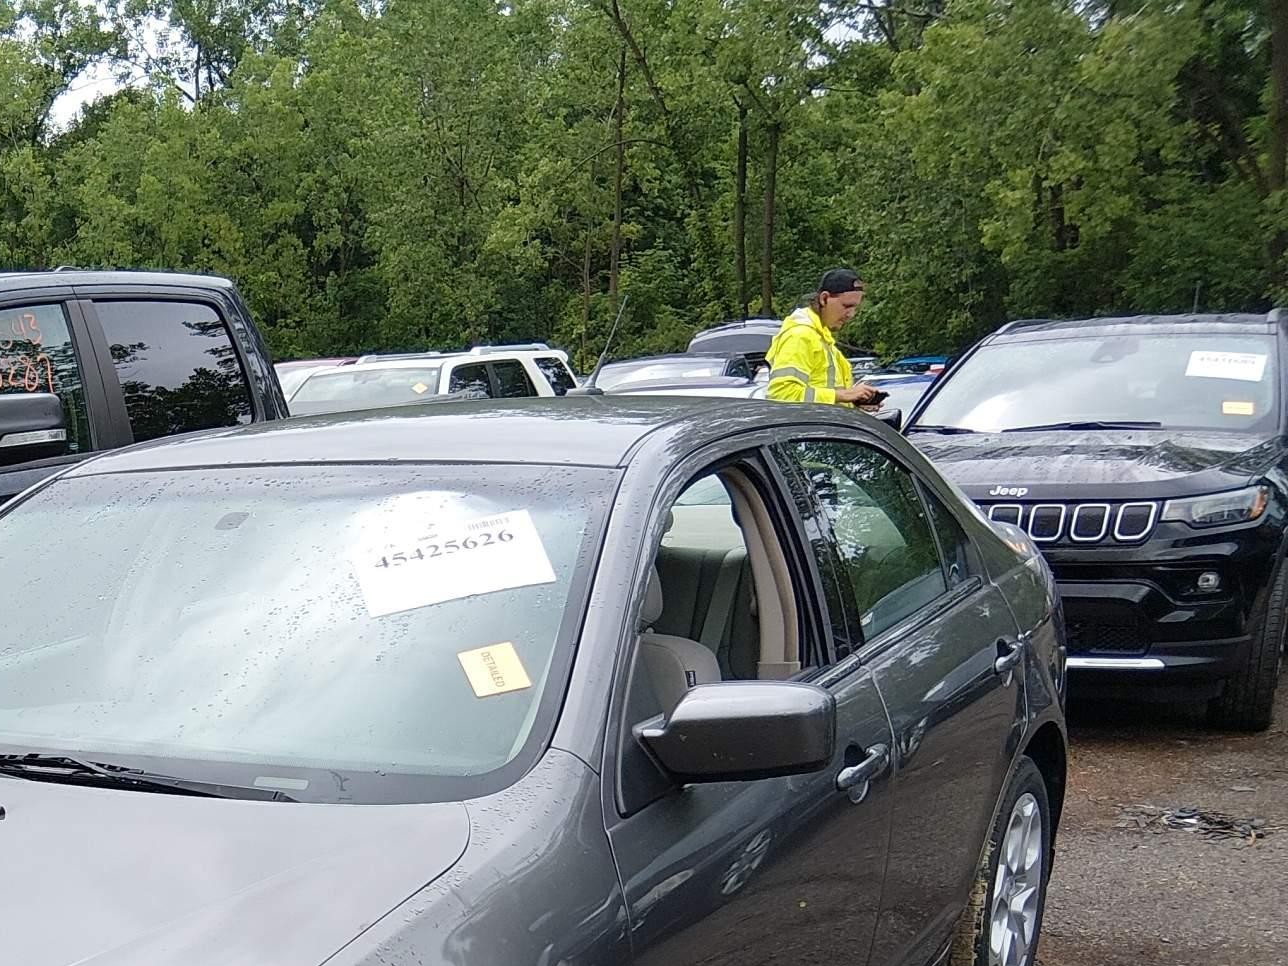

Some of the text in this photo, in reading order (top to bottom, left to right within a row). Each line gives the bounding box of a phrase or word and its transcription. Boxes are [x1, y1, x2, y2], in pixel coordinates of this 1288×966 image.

[989, 485, 1028, 498] Jeep
[374, 529, 514, 568] 45425626
[478, 651, 505, 688] DETAILED
